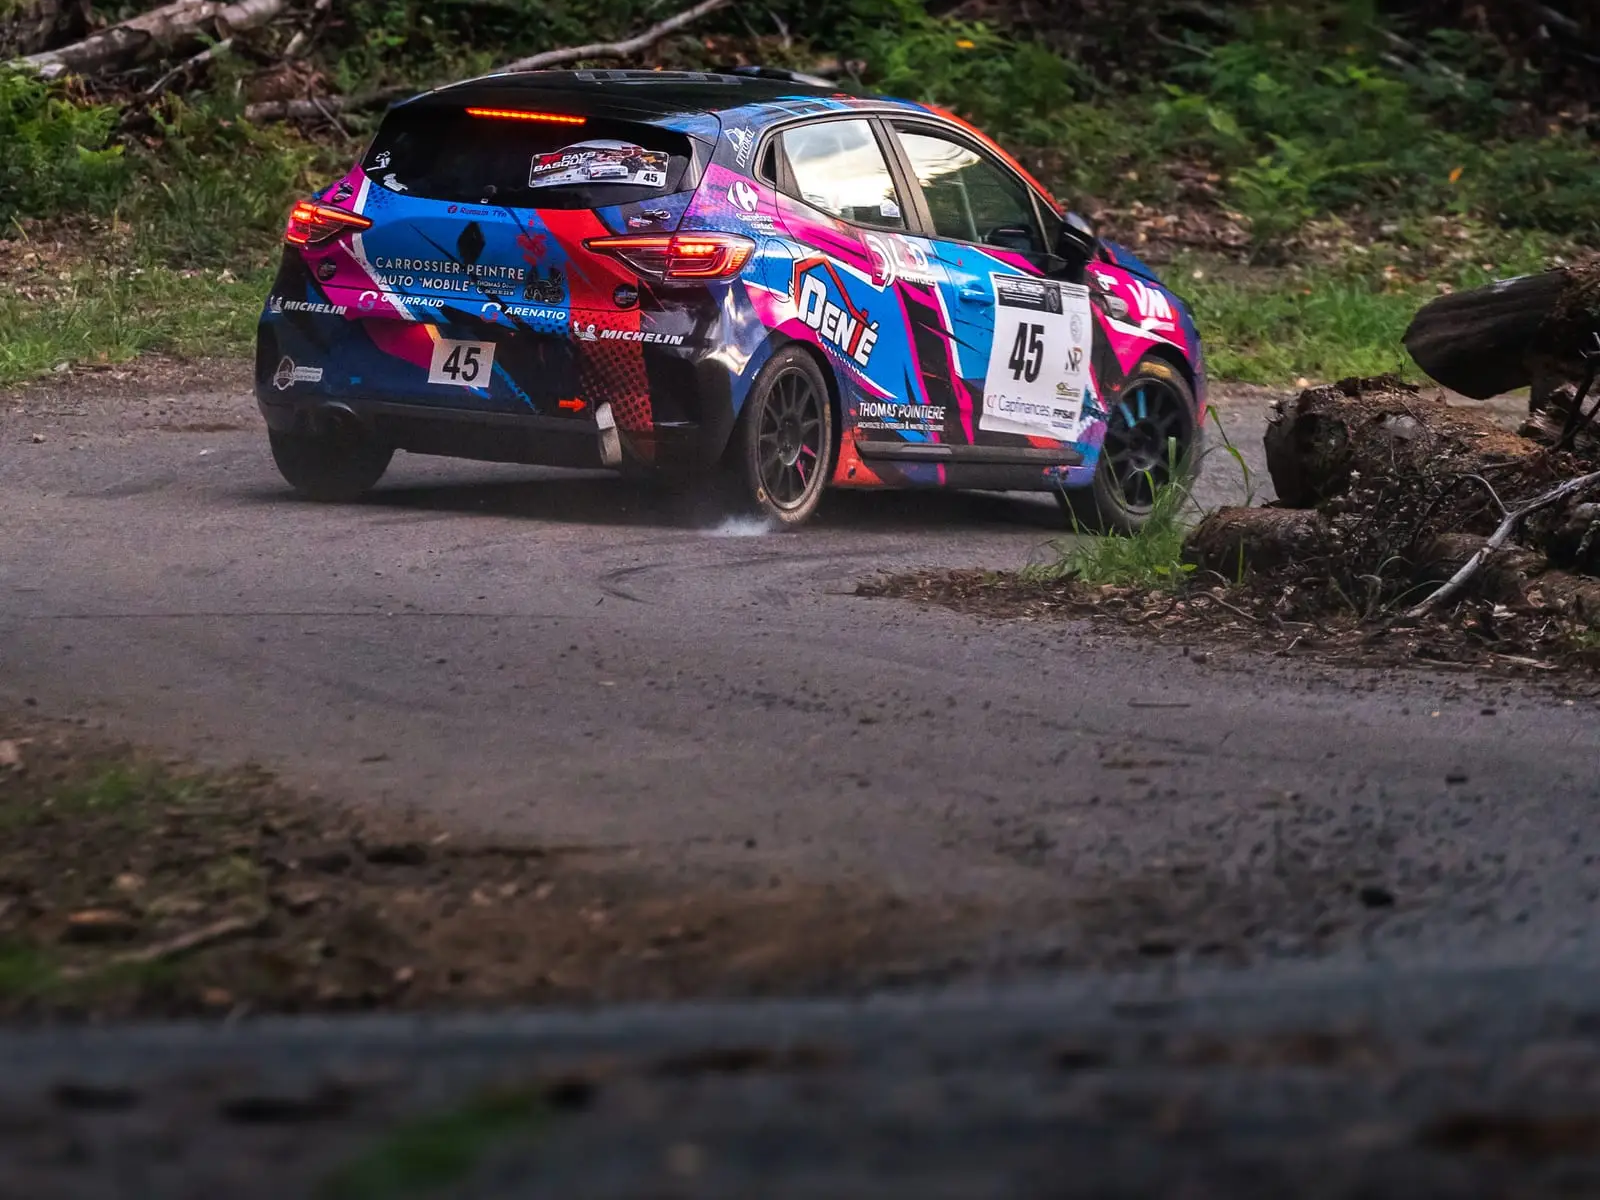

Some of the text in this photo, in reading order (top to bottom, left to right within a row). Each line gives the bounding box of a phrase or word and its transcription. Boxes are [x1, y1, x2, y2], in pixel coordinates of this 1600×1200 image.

[561, 151, 597, 162] PAYS
[533, 158, 588, 173] BASQUE
[642, 172, 659, 183] 45
[379, 275, 414, 288] AUTO
[283, 300, 348, 316] MICHELIN
[1125, 279, 1173, 320] VM
[504, 305, 567, 321] ARENATIO
[600, 328, 684, 346] MICHELIN
[1008, 321, 1045, 384] 45
[442, 344, 481, 382] 45
[859, 402, 947, 420] THOMAS POINTIERE
[999, 394, 1050, 417] Capfinances
